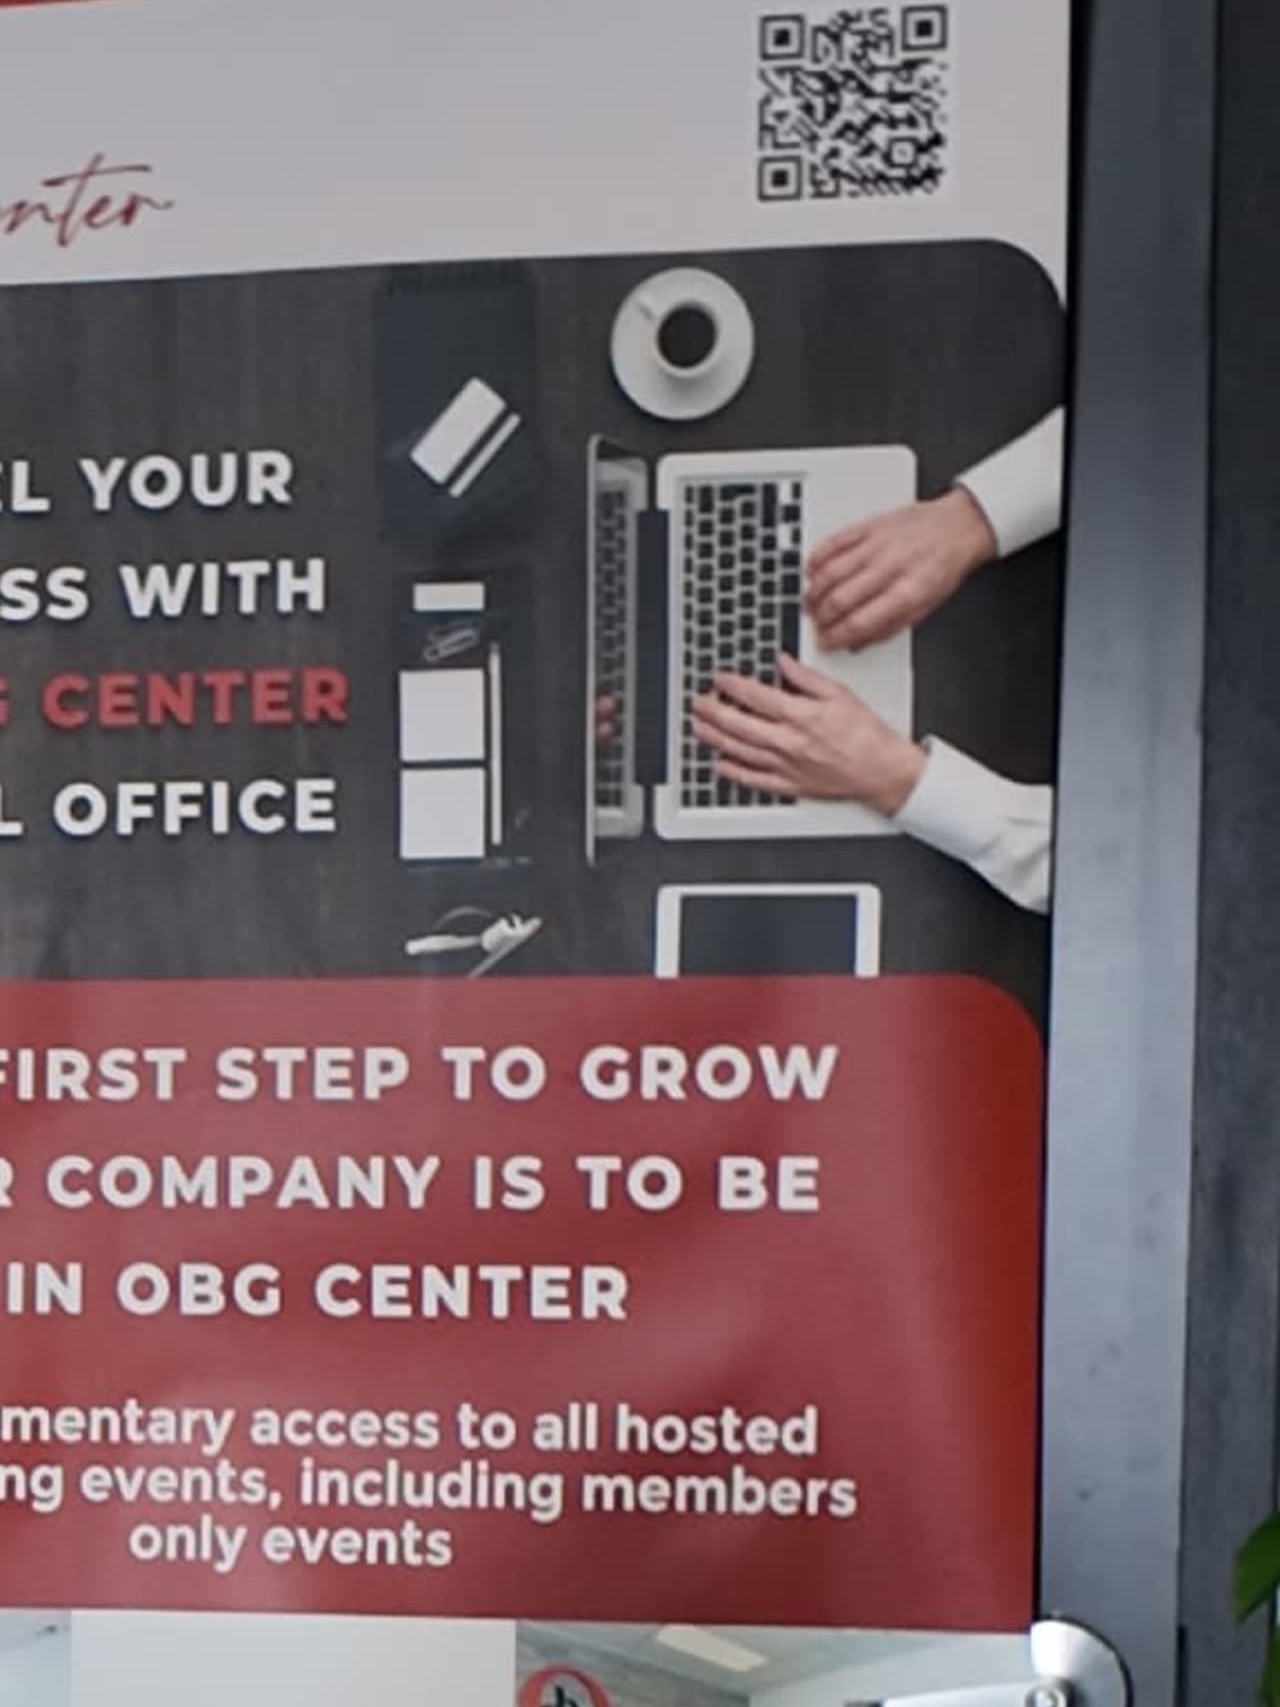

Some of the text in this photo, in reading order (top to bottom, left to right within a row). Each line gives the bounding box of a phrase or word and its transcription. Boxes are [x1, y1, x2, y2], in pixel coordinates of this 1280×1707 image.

[80, 450, 292, 510] YOUR
[120, 558, 324, 617] WITH
[42, 667, 347, 728] CENTER
[53, 779, 335, 835] OFFICE
[217, 1047, 409, 1100] STEP
[441, 1046, 546, 1100] TO
[580, 1045, 838, 1100] GROW
[47, 1155, 439, 1209] COMPANY
[475, 1156, 544, 1210] IS
[576, 1155, 682, 1210] TO
[719, 1156, 819, 1211] BE
[7, 1262, 627, 1320] IN OBG CENTER
[250, 1409, 439, 1448] access
[457, 1403, 516, 1449] to
[533, 1402, 598, 1450] all
[617, 1403, 817, 1454] hosted
[81, 1458, 281, 1510] events,
[301, 1456, 563, 1522] including
[583, 1465, 857, 1516] members
[129, 1513, 452, 1573] only events
